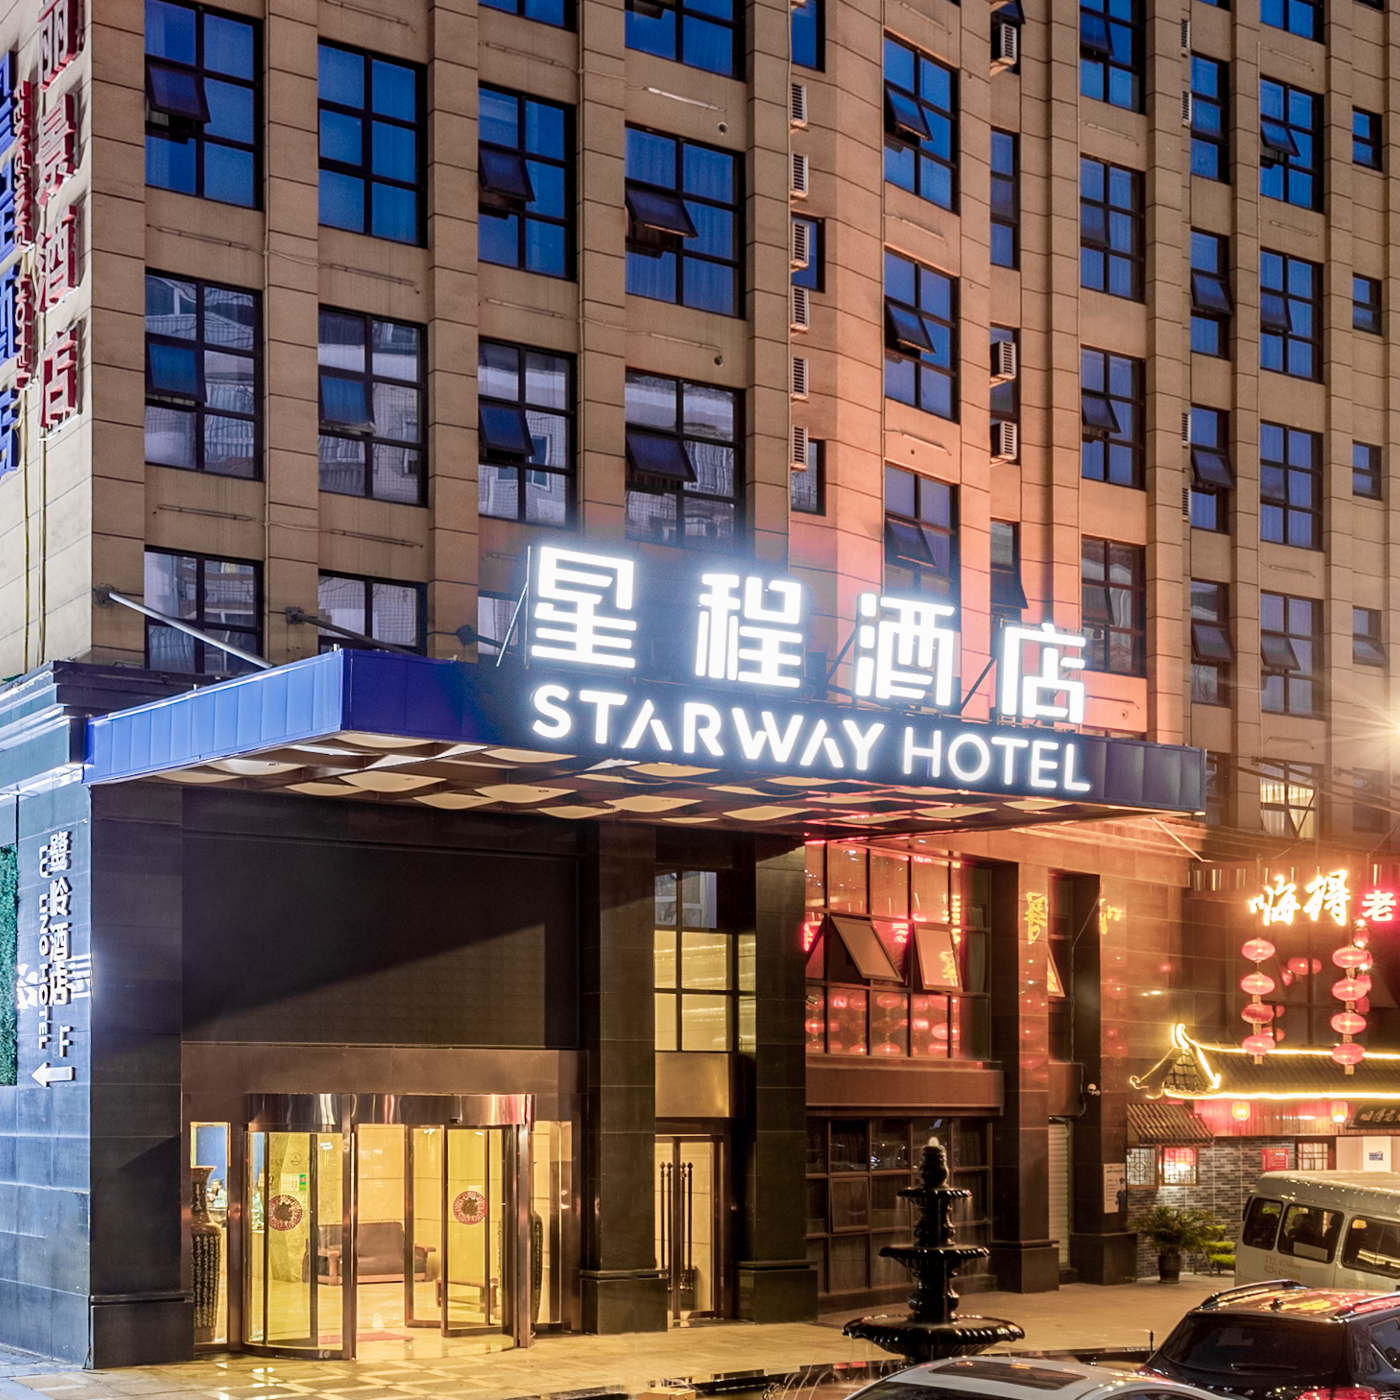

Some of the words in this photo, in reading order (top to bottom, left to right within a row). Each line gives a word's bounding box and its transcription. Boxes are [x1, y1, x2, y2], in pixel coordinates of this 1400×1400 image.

[15, 273, 35, 390] HOTEL
[530, 545, 1088, 725] 星程酒店
[531, 682, 886, 772] STARWAY
[902, 725, 1093, 793] HOTEL
[38, 844, 52, 879] LU
[38, 962, 52, 1050] HOTEL
